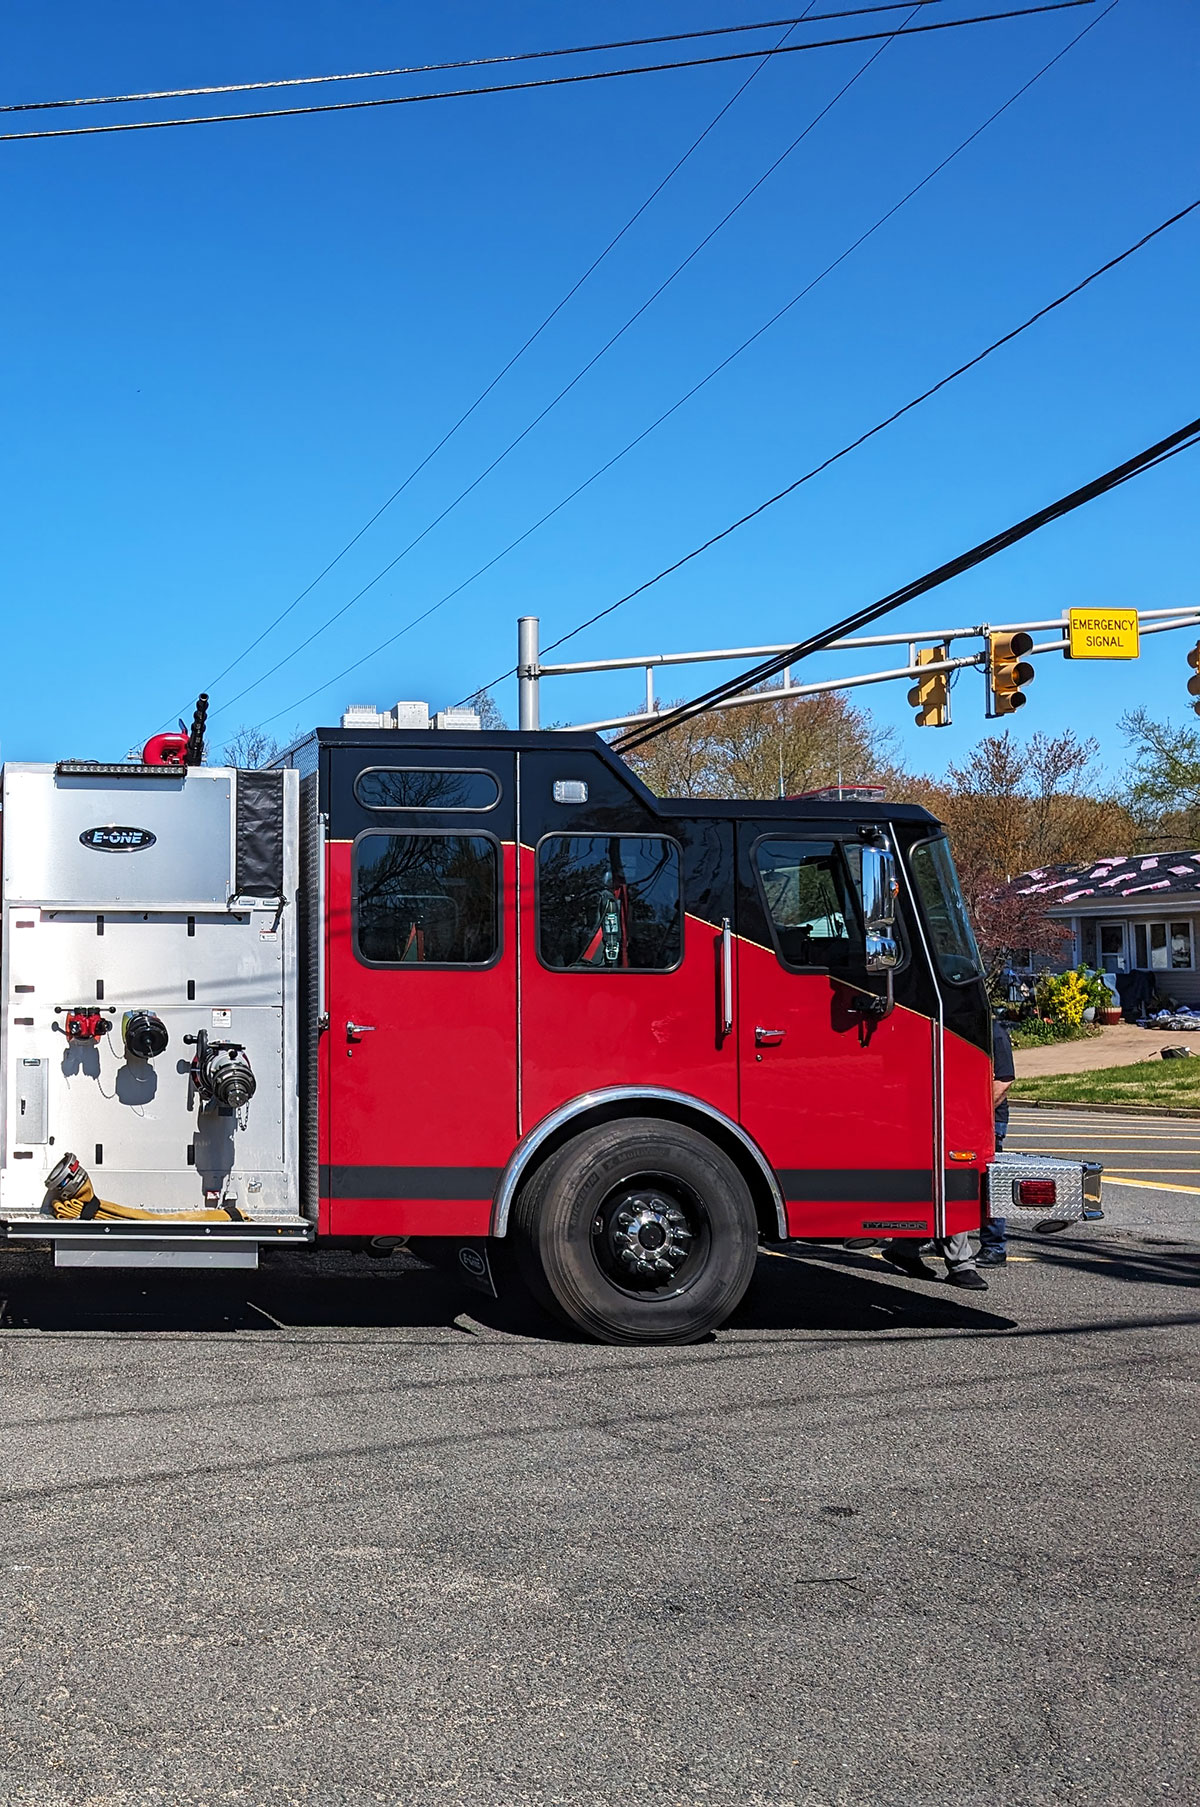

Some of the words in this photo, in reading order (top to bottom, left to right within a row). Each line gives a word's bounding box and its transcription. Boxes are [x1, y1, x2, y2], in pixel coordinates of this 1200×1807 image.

[1072, 618, 1136, 632] EMERGENCY
[1086, 636, 1125, 648] SIGNAL
[92, 831, 144, 844] E-ONE
[862, 1221, 927, 1230] TYPHOON
